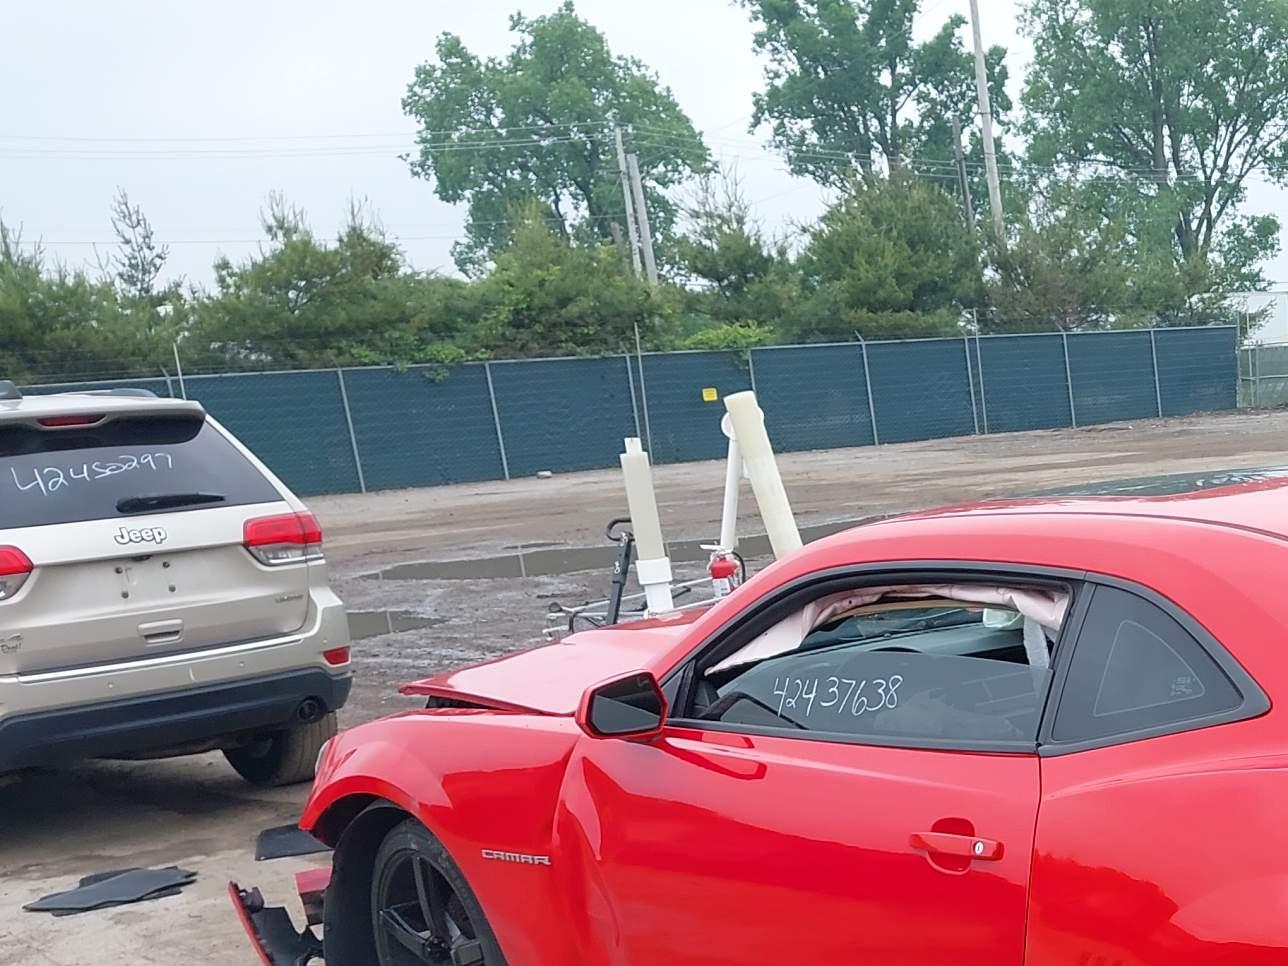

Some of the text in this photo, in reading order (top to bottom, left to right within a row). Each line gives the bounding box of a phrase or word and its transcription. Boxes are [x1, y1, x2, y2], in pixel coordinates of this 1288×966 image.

[11, 453, 173, 496] 42450297
[114, 526, 168, 544] Jeep
[773, 675, 903, 717] 42437638
[481, 849, 552, 865] CAMAR
